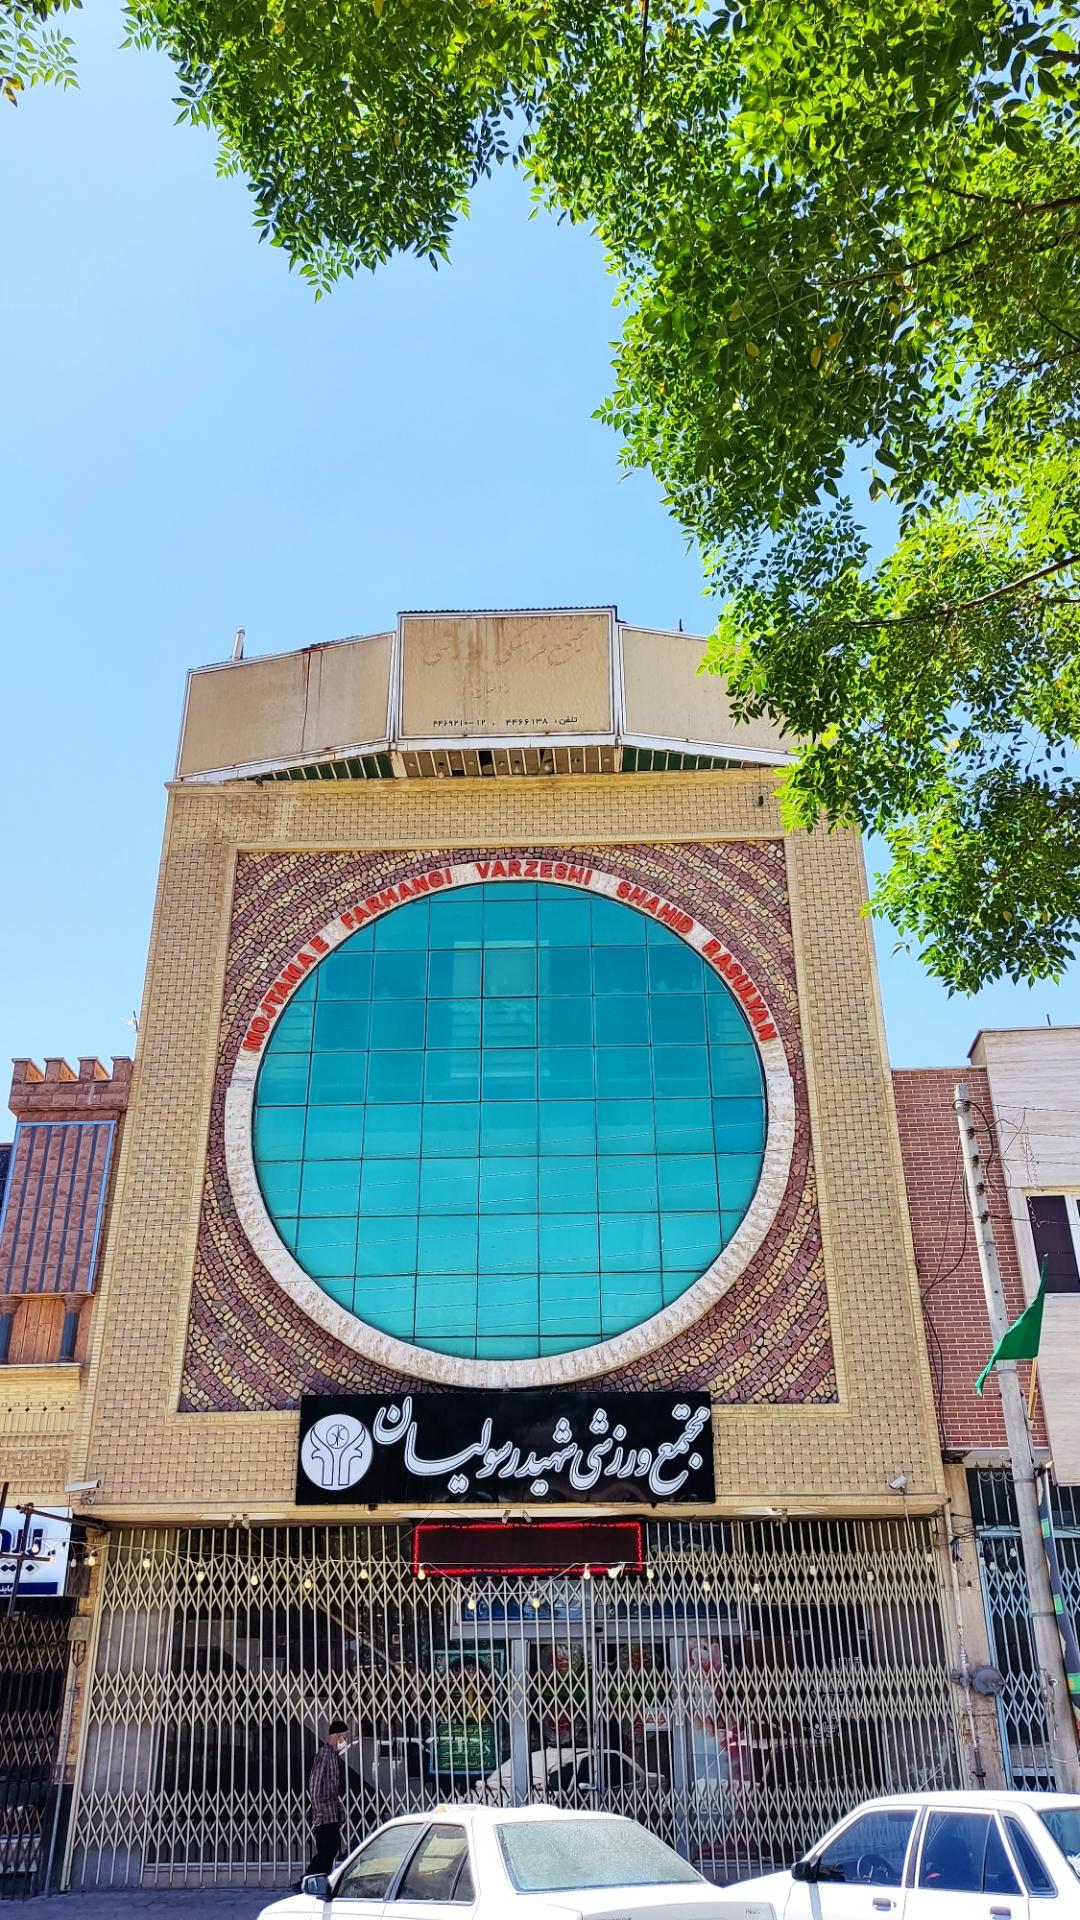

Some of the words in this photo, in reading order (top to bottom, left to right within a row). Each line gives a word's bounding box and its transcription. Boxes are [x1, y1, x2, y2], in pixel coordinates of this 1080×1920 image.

[340, 868, 453, 930] FARHANGI
[474, 859, 593, 885] VARZESHI
[615, 880, 694, 934] SHAHID
[702, 938, 778, 1042] RASULYAN
[373, 1395, 520, 1495] رسولیان
[514, 1416, 578, 1497] شهید
[569, 1407, 653, 1491] ورزشی
[649, 1403, 711, 1496] مجتمع
